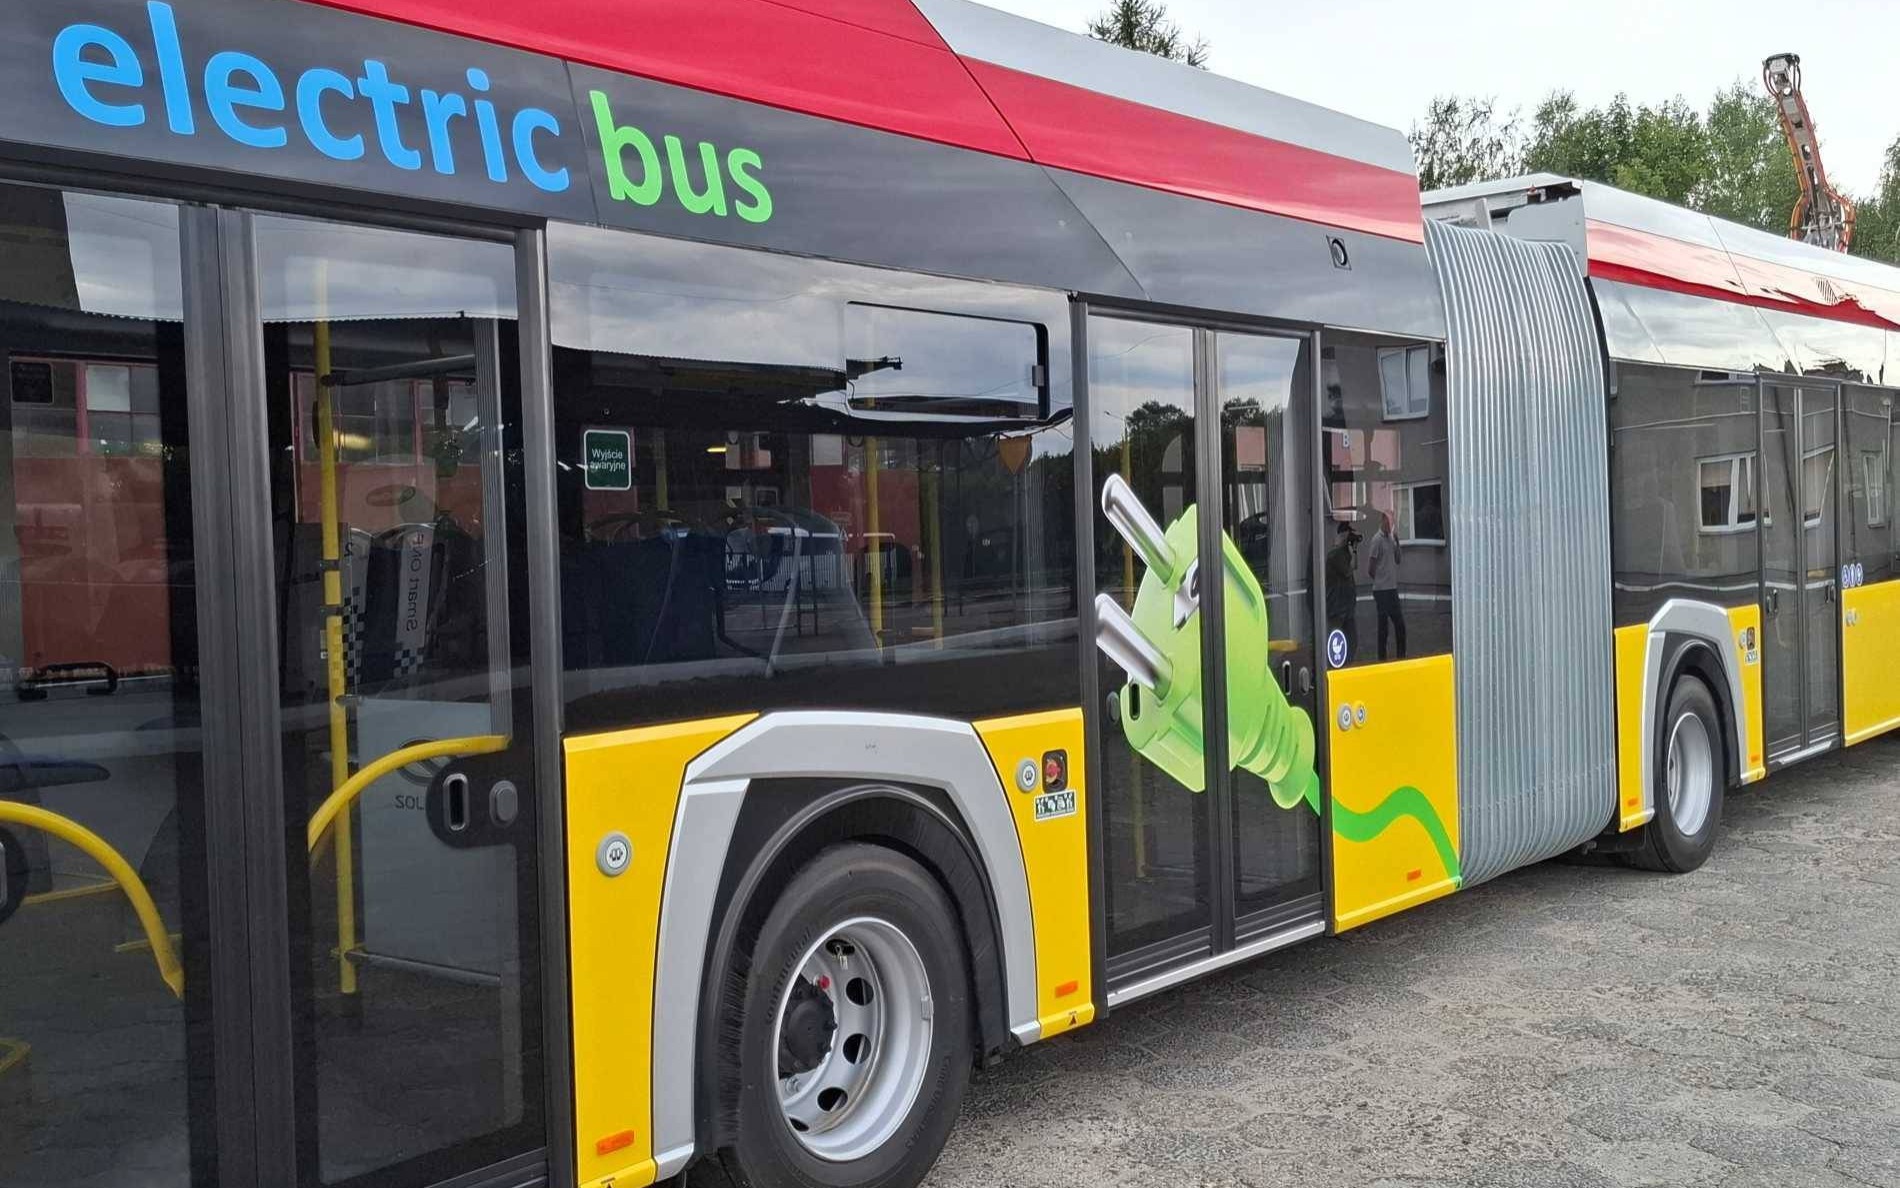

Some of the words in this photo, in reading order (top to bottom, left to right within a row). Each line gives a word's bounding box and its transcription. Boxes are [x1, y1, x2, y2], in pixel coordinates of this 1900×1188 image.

[52, 0, 570, 193] electric
[589, 90, 774, 223] bus
[589, 460, 626, 472] awaryjne
[592, 448, 623, 461] Wyjście
